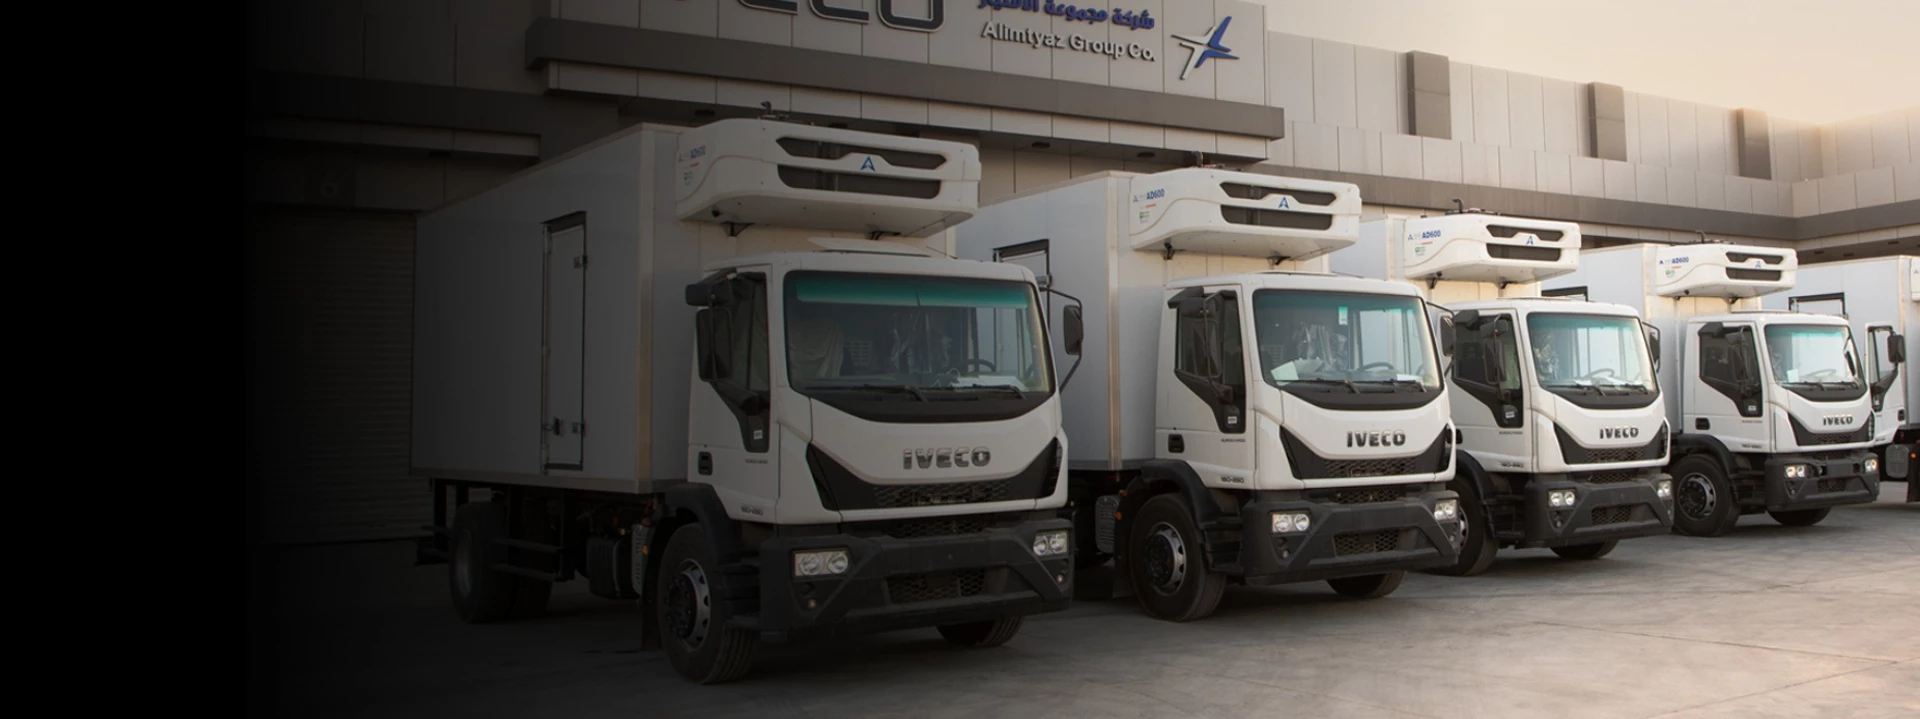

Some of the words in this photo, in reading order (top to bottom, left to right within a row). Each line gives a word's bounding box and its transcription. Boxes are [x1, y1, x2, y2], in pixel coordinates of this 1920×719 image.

[1112, 7, 1155, 30] شركة
[982, 21, 1066, 49] Alimtyaz
[1069, 33, 1125, 60] Group
[1127, 42, 1156, 62] Co.
[1146, 188, 1166, 200] AD600
[1421, 229, 1442, 239] AD600
[1823, 414, 1853, 427] IVECO
[1346, 430, 1406, 448] IVECO
[1599, 426, 1639, 440] IVECO
[903, 447, 991, 470] IVECO
